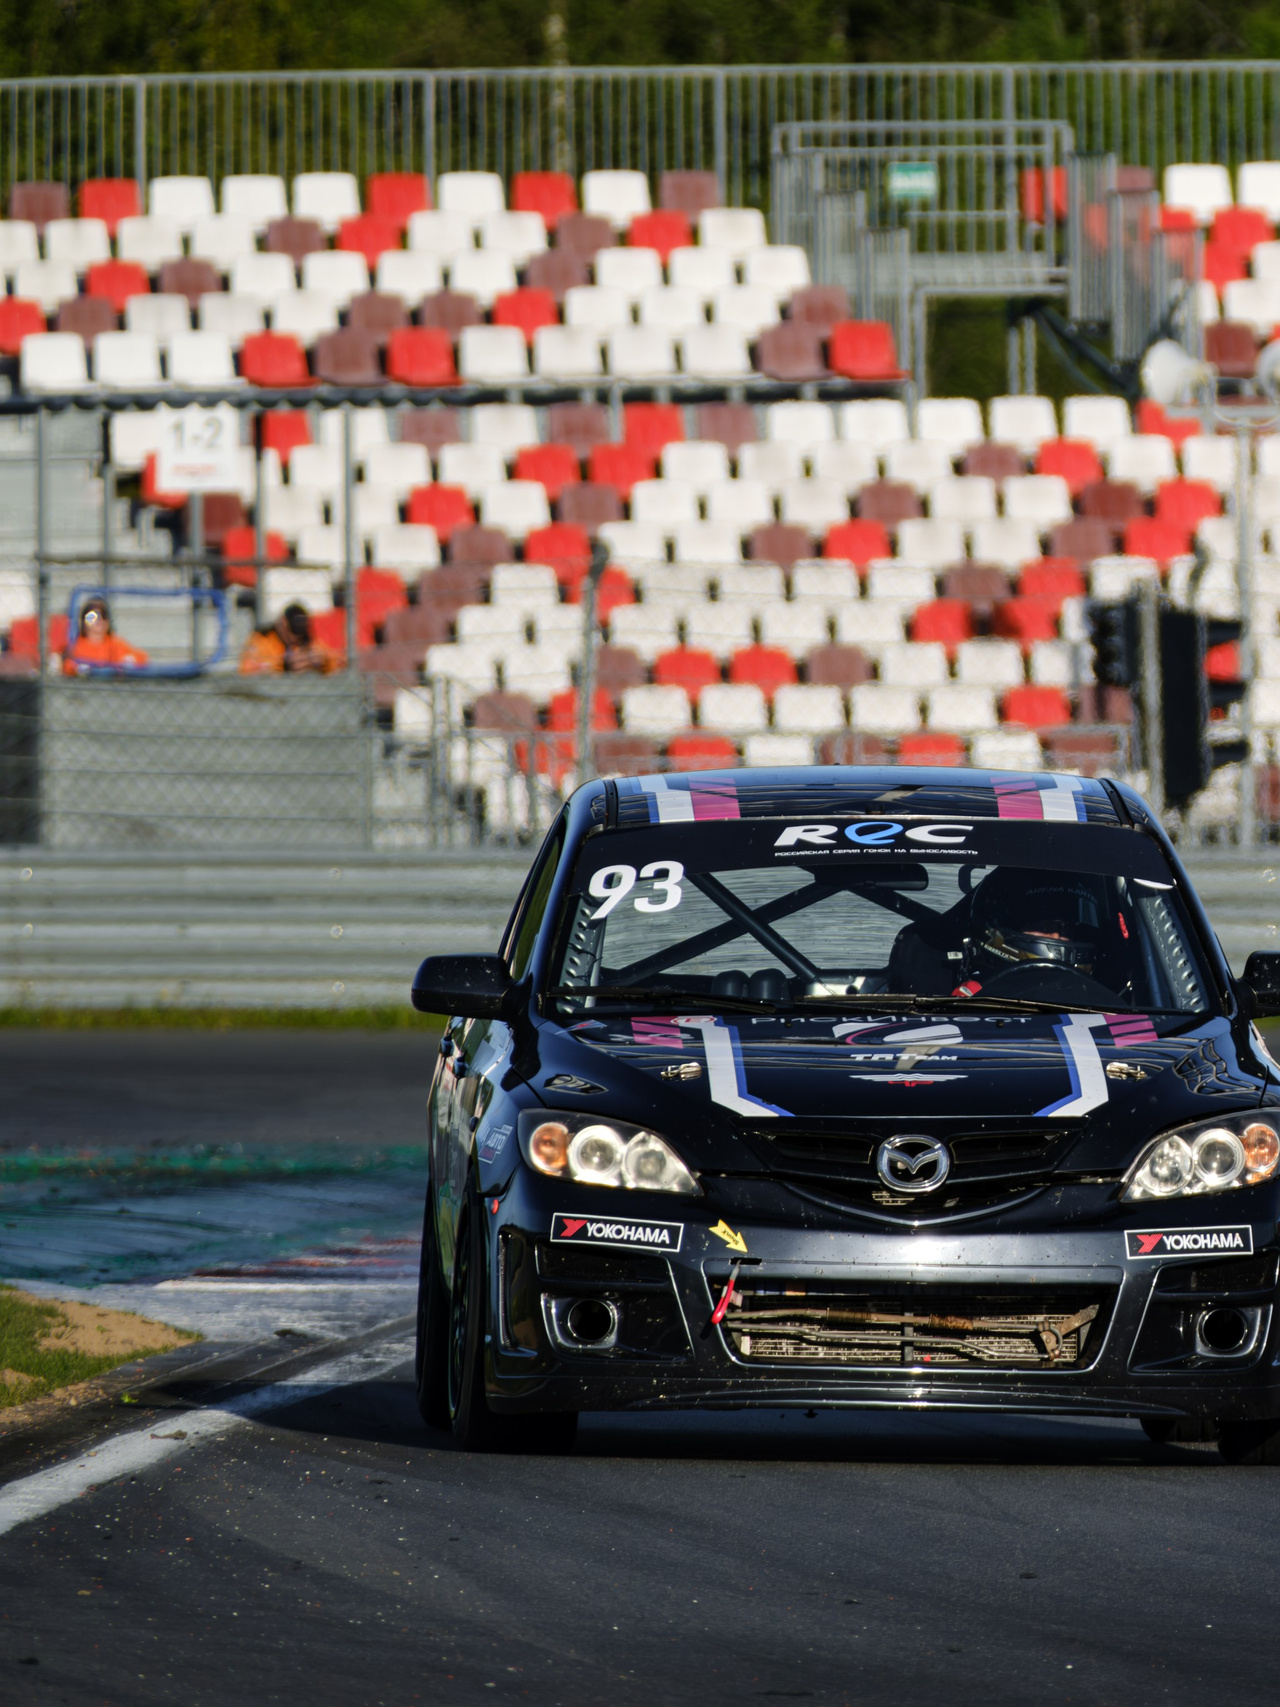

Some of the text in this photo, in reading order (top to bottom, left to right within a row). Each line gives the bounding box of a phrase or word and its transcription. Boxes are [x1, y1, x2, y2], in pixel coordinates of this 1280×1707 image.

[168, 416, 224, 451] 1-2
[774, 849, 830, 857] РОССИЙСКАЯ
[588, 860, 685, 920] 93
[586, 1222, 670, 1244] YOKOHAMA
[1162, 1232, 1244, 1250] YOKOHAMA
